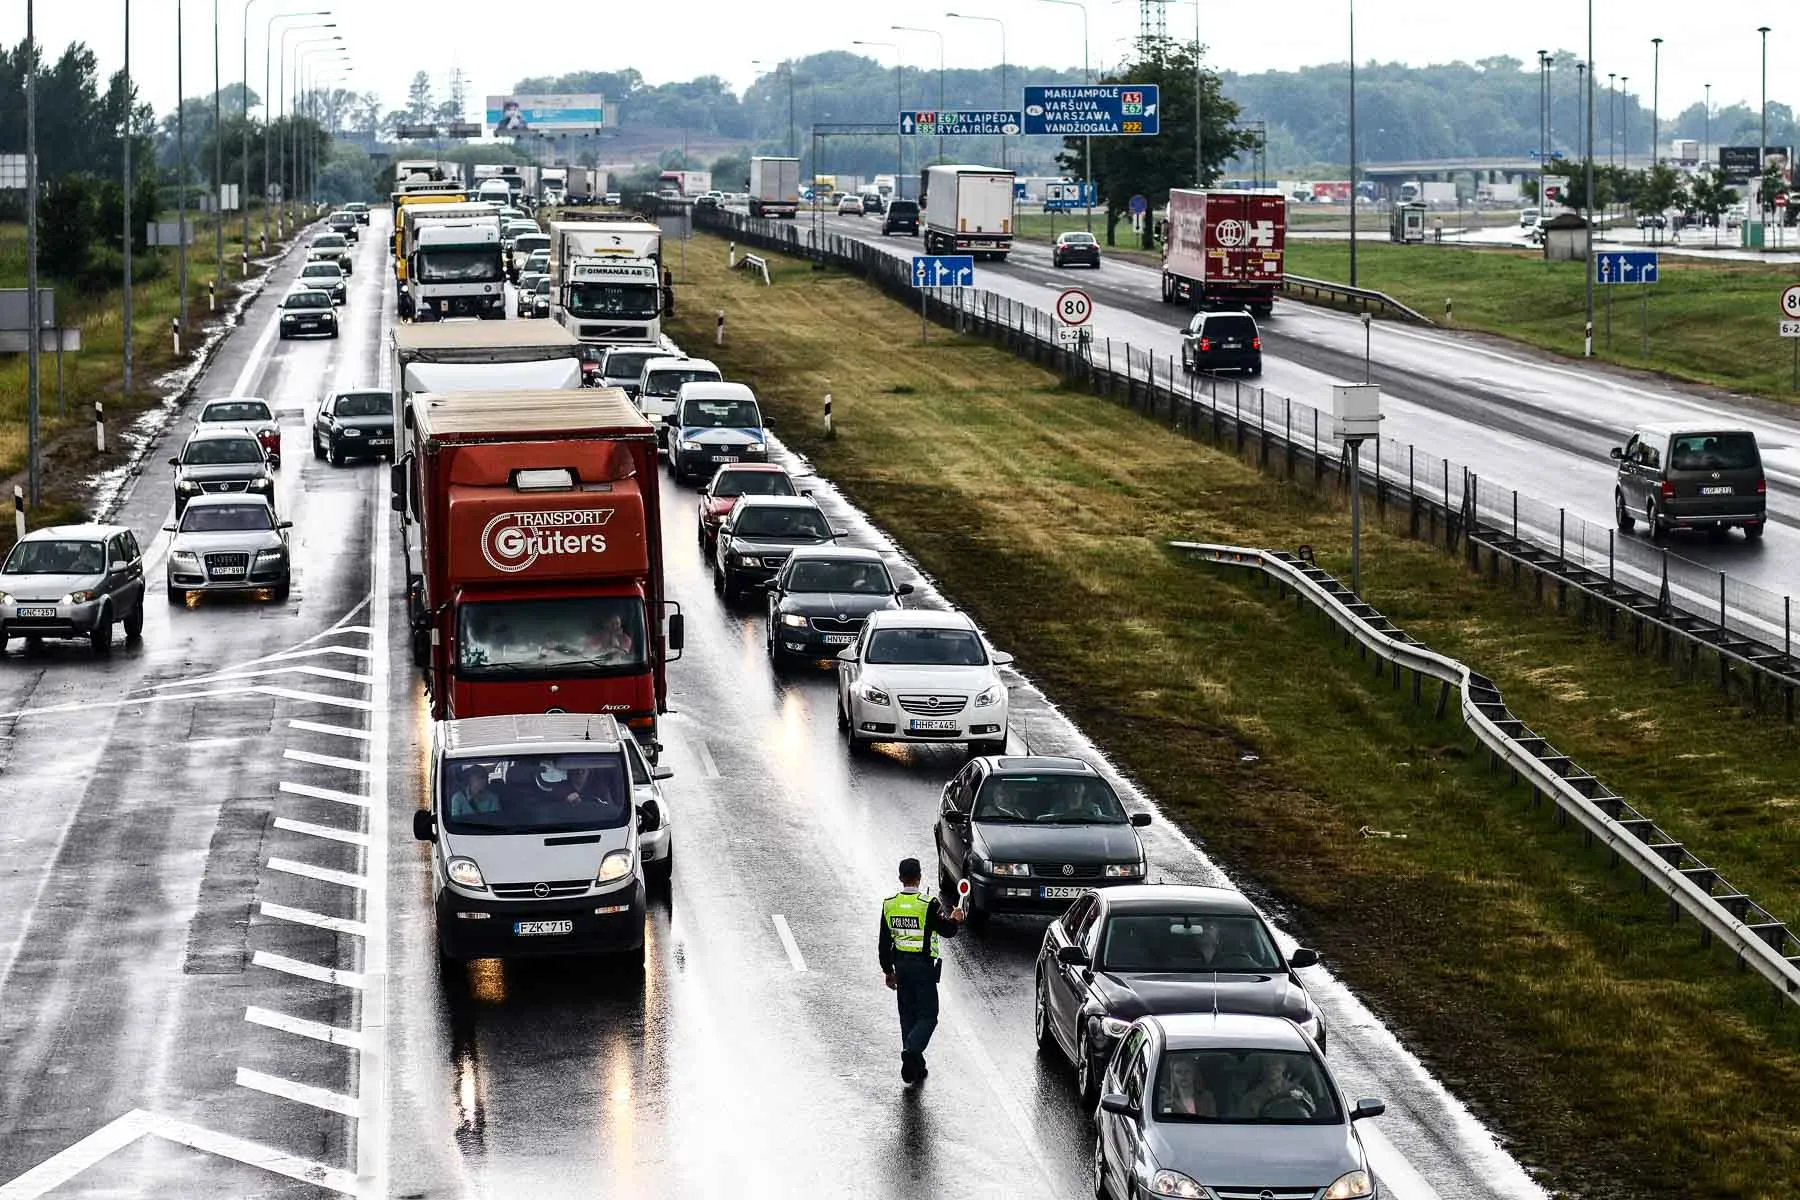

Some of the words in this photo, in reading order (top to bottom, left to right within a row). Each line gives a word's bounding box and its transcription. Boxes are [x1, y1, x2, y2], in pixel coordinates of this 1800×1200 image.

[1044, 89, 1119, 98] MARIJAMPOLĖ
[1124, 94, 1140, 103] A5
[1045, 99, 1098, 110] VARŠUVA
[1123, 104, 1141, 113] E67
[919, 113, 933, 123] A1
[937, 113, 958, 123] E67
[959, 112, 1016, 122] KLAIPĖDA
[1045, 111, 1111, 120] WARSZAWA
[1045, 121, 1119, 132] VANDŽIOGALA
[1065, 300, 1085, 314] 80
[1788, 295, 1800, 308] 8
[514, 511, 603, 526] TRANSPORT
[497, 528, 607, 556] Grüters
[916, 721, 934, 729] HHR
[939, 721, 954, 729] 445
[1047, 888, 1069, 897] BZS
[520, 923, 544, 933] FZK
[551, 921, 571, 932] 715
